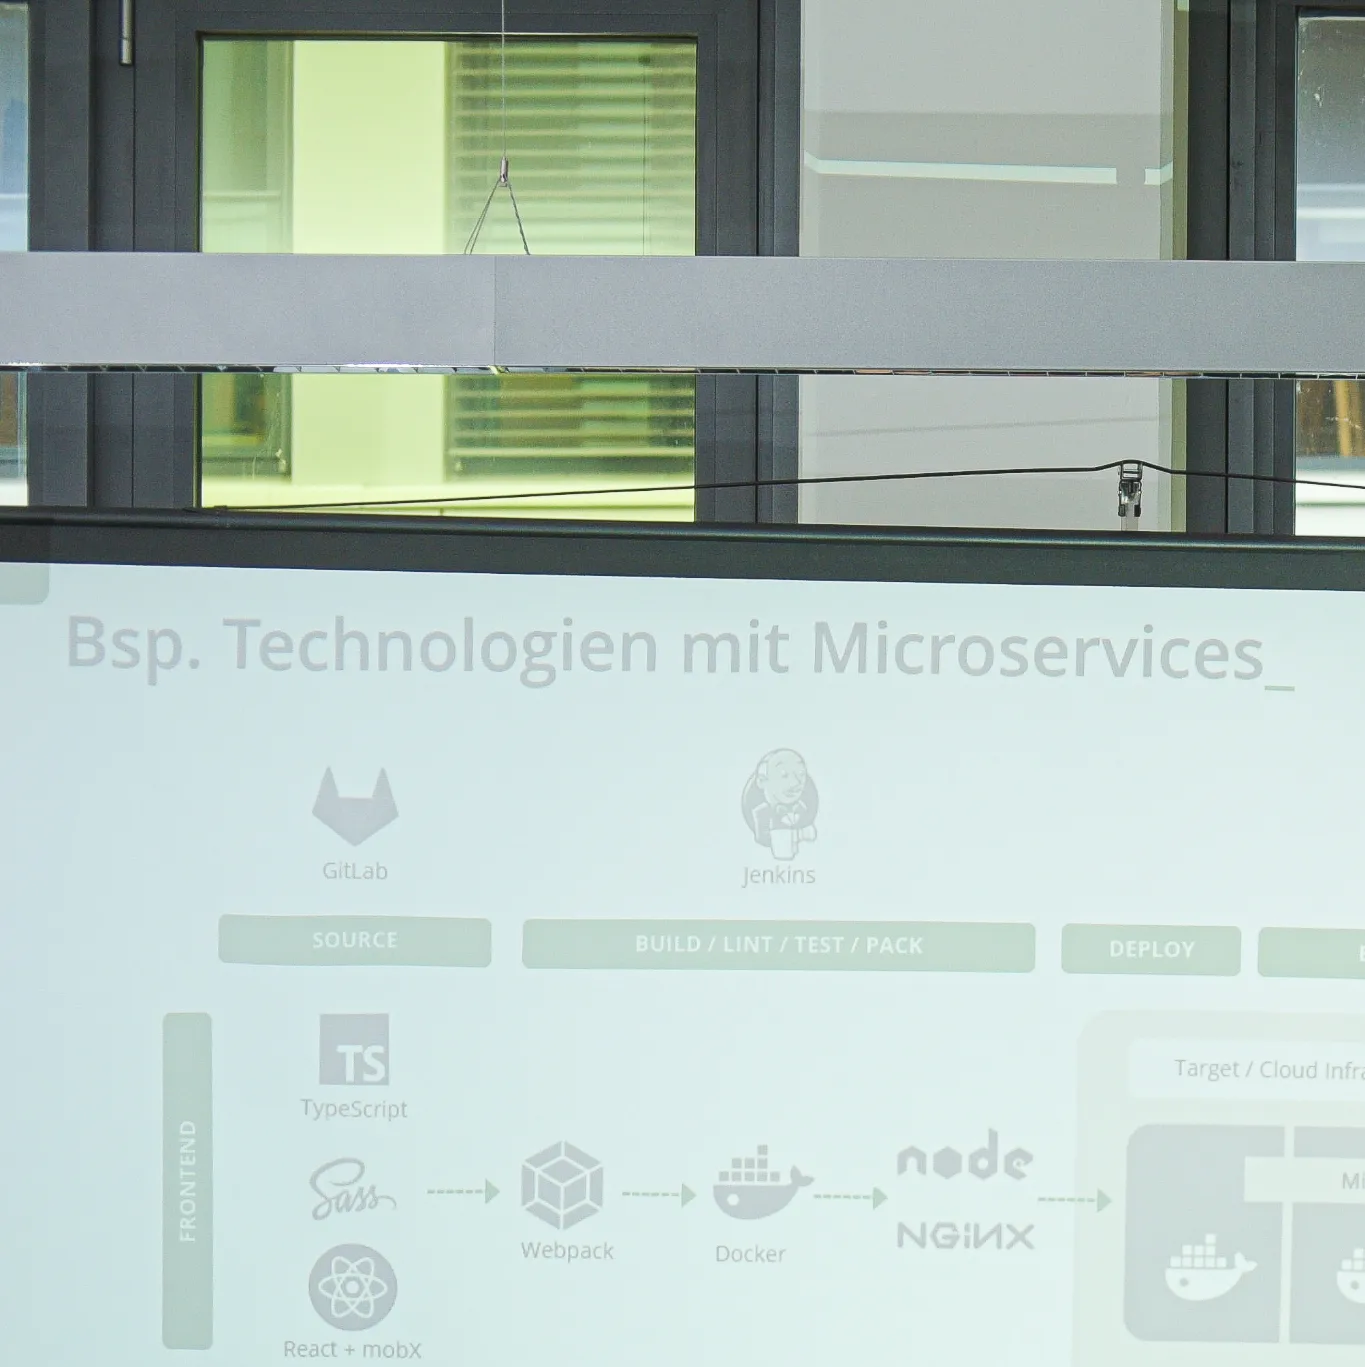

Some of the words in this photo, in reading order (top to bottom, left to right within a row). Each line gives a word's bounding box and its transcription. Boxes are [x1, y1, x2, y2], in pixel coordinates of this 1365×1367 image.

[69, 615, 199, 686] Bsp.
[222, 615, 656, 688] Technologien
[684, 619, 789, 673] mit
[814, 620, 1295, 691] Microservices_
[323, 862, 388, 880] GitLab
[742, 866, 815, 888] Jenkins
[313, 932, 396, 948] SOURCE
[636, 935, 701, 952] BUILD
[724, 936, 772, 953] LINT
[795, 936, 844, 953] TEST
[867, 937, 922, 954] PACK
[1110, 940, 1194, 958] DEPLOY
[337, 1045, 385, 1082] TS
[1175, 1059, 1239, 1082] Target
[1260, 1061, 1317, 1079] Cloud
[301, 1099, 407, 1121] TypeScript
[897, 1128, 1033, 1180] node
[179, 1120, 196, 1243] FRONTEND
[309, 1158, 396, 1220] Sass
[521, 1242, 613, 1263] Webpack
[716, 1245, 786, 1262] Docker
[284, 1341, 337, 1358] React
[363, 1342, 421, 1359] mobX
